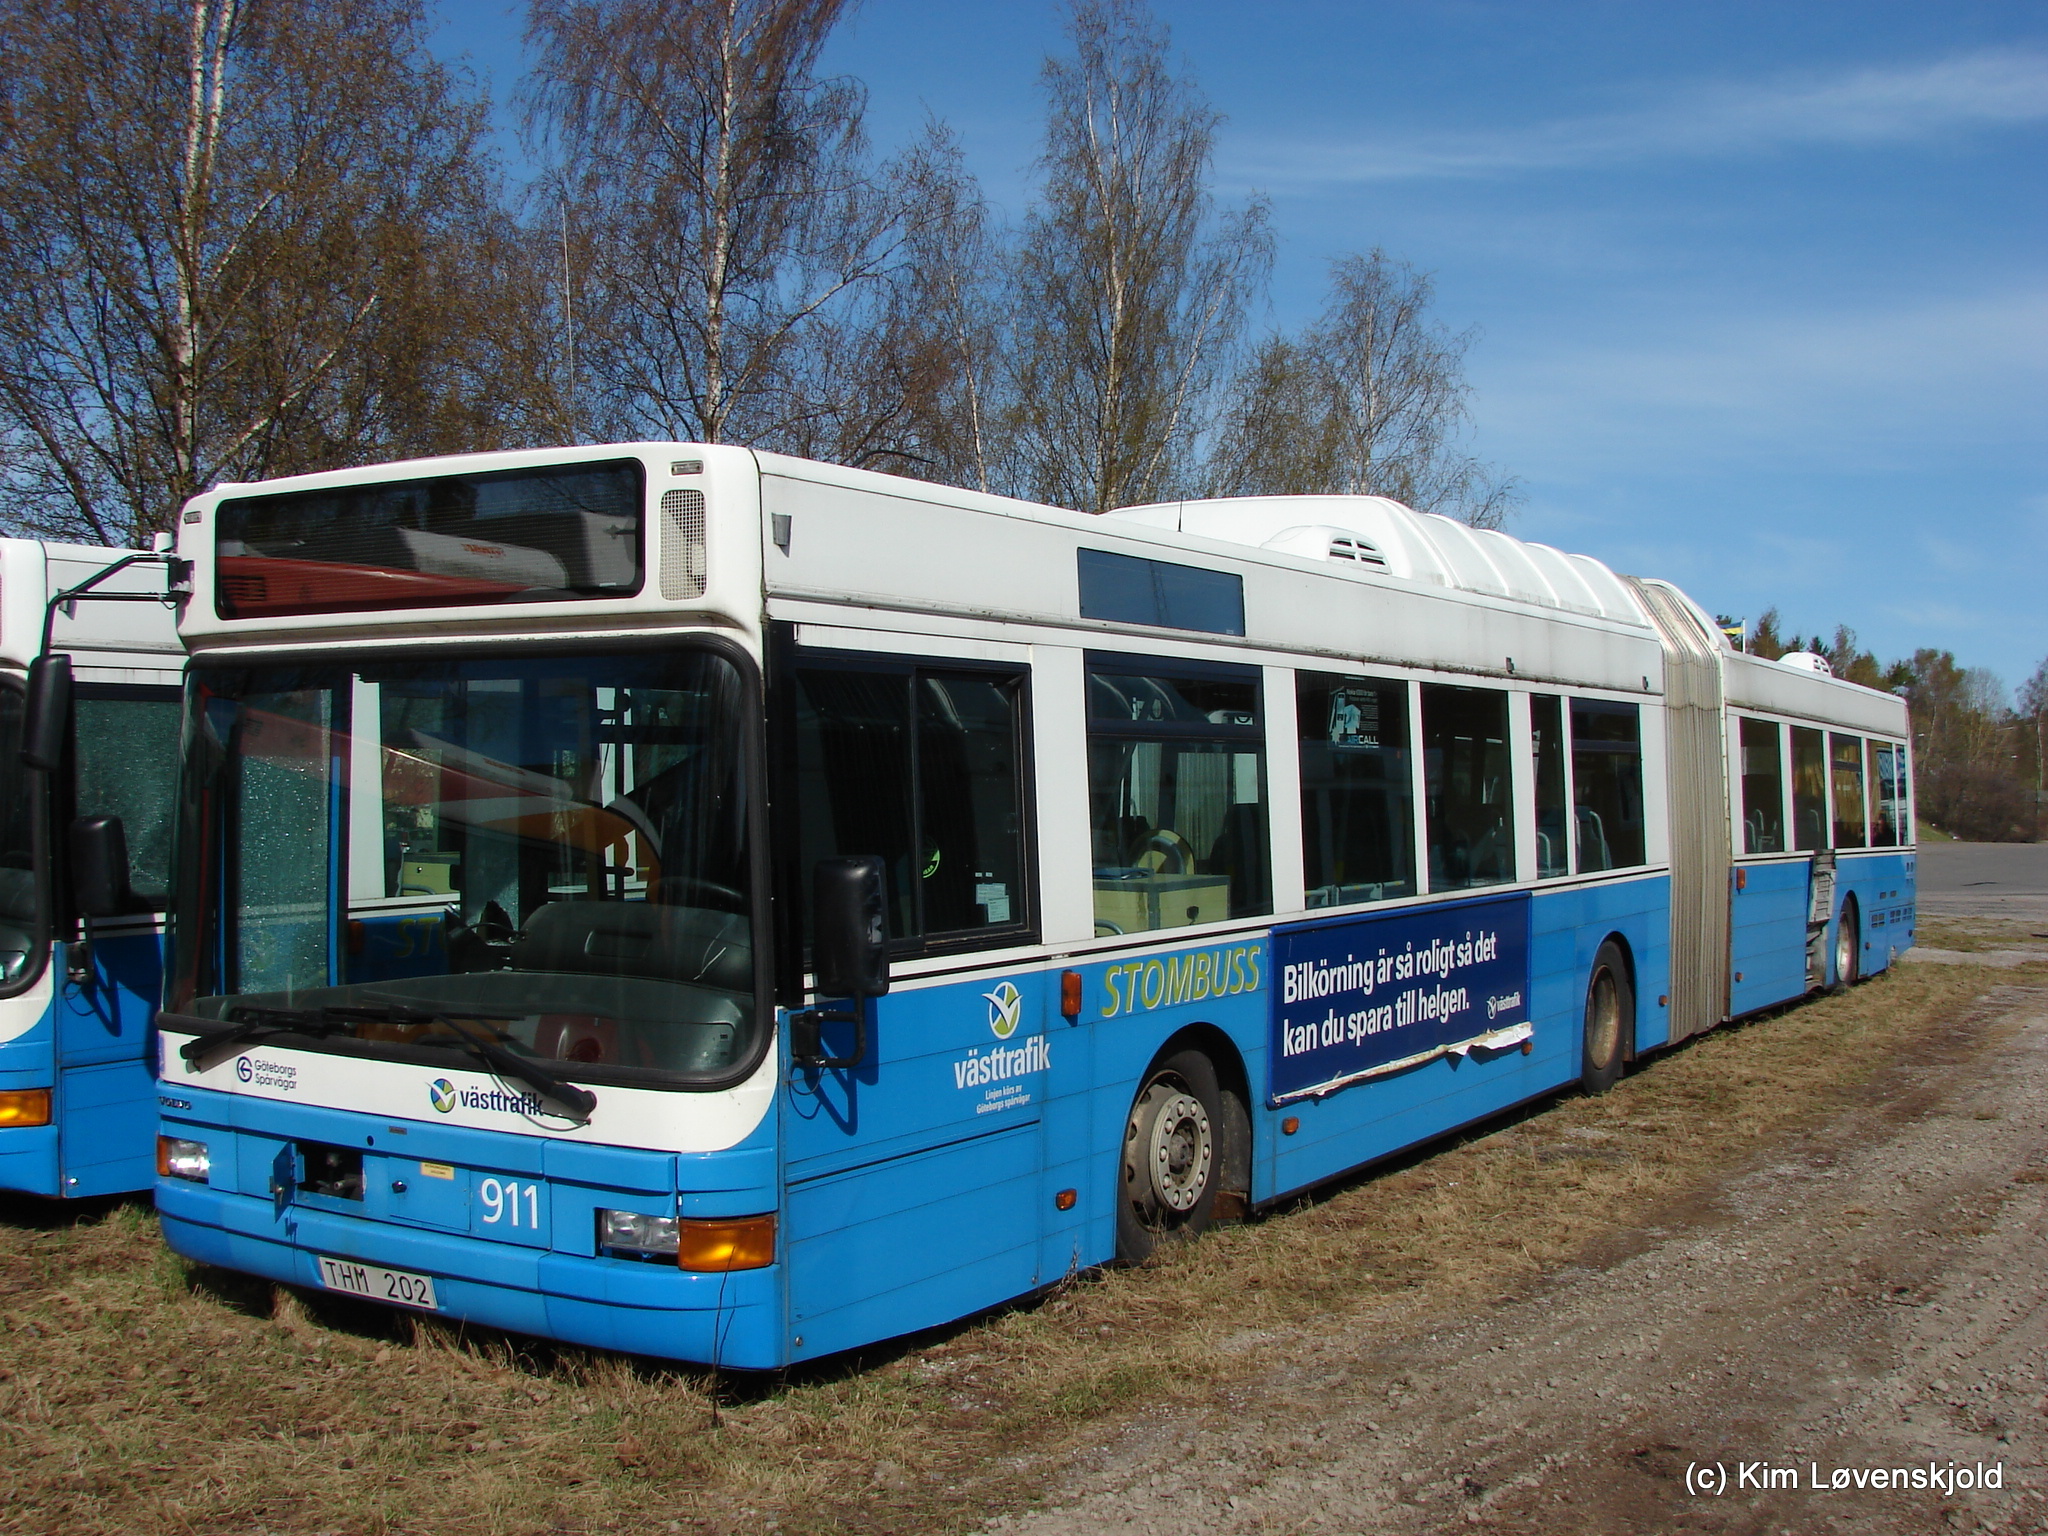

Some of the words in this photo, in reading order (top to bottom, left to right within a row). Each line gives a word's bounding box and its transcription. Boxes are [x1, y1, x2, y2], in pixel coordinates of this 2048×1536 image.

[1102, 945, 1261, 1018] STOMBUSS
[1283, 954, 1374, 1004] Bilkörning
[1376, 948, 1394, 985] är
[1395, 941, 1413, 981] så
[1416, 938, 1455, 979] roligt
[1456, 931, 1473, 968] så
[1474, 930, 1497, 963] det
[1283, 1019, 1318, 1057] kan
[1321, 1009, 1344, 1047] du
[1347, 1005, 1392, 1046] spara
[1395, 989, 1415, 1027] till
[1418, 984, 1470, 1024] helgen.
[254, 1059, 297, 1078] Göteborgs
[254, 1073, 297, 1091] Spårvägar
[954, 1035, 1051, 1090] västtrafik
[460, 1086, 544, 1117] västtrafik
[976, 1101, 1004, 1114] Göteborgs
[985, 1087, 1002, 1101] Linjen
[481, 1178, 539, 1229] 911
[325, 1261, 370, 1293] THM
[384, 1272, 430, 1304] 202
